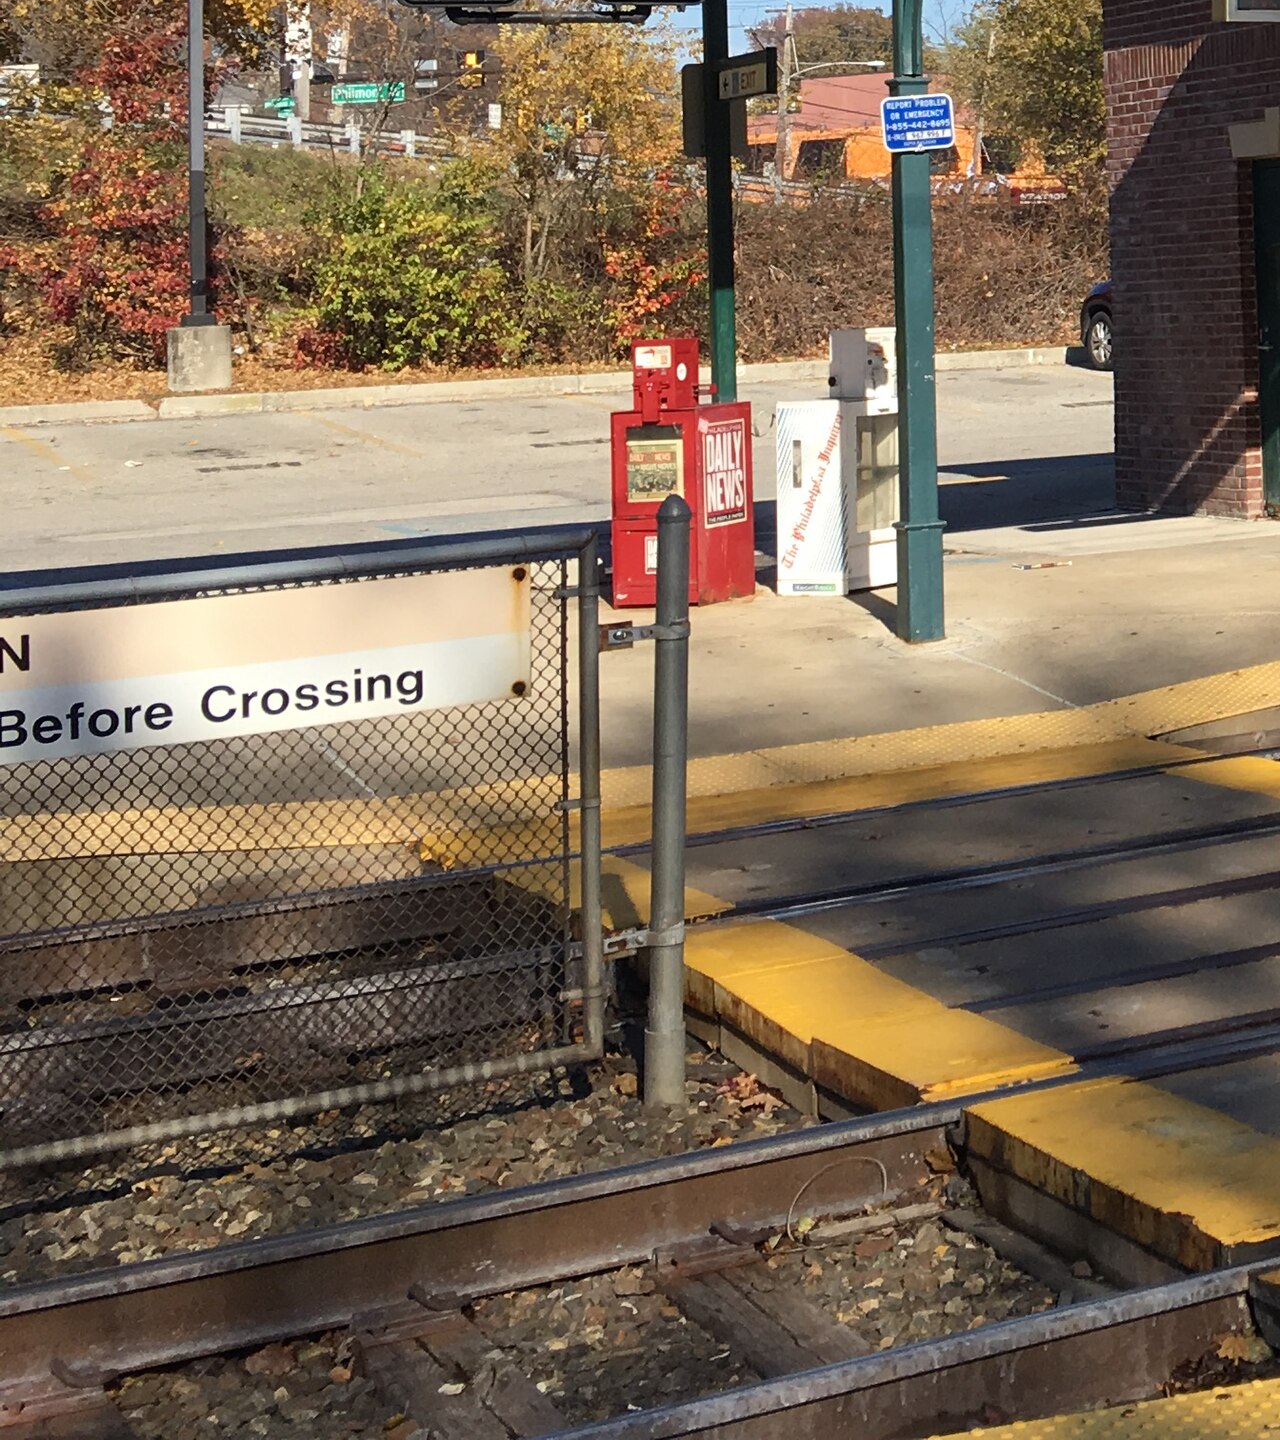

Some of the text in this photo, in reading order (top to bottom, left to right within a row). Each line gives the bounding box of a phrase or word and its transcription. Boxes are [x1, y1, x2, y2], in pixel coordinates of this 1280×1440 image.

[886, 98, 947, 110] REPORT PROBLEM
[890, 109, 944, 120] OR EMERGENCY
[706, 431, 742, 473] DAILY
[707, 469, 744, 513] NEWS
[782, 544, 799, 569] The
[791, 466, 826, 542] Philadelphia
[0, 668, 424, 749] Before Crossing
